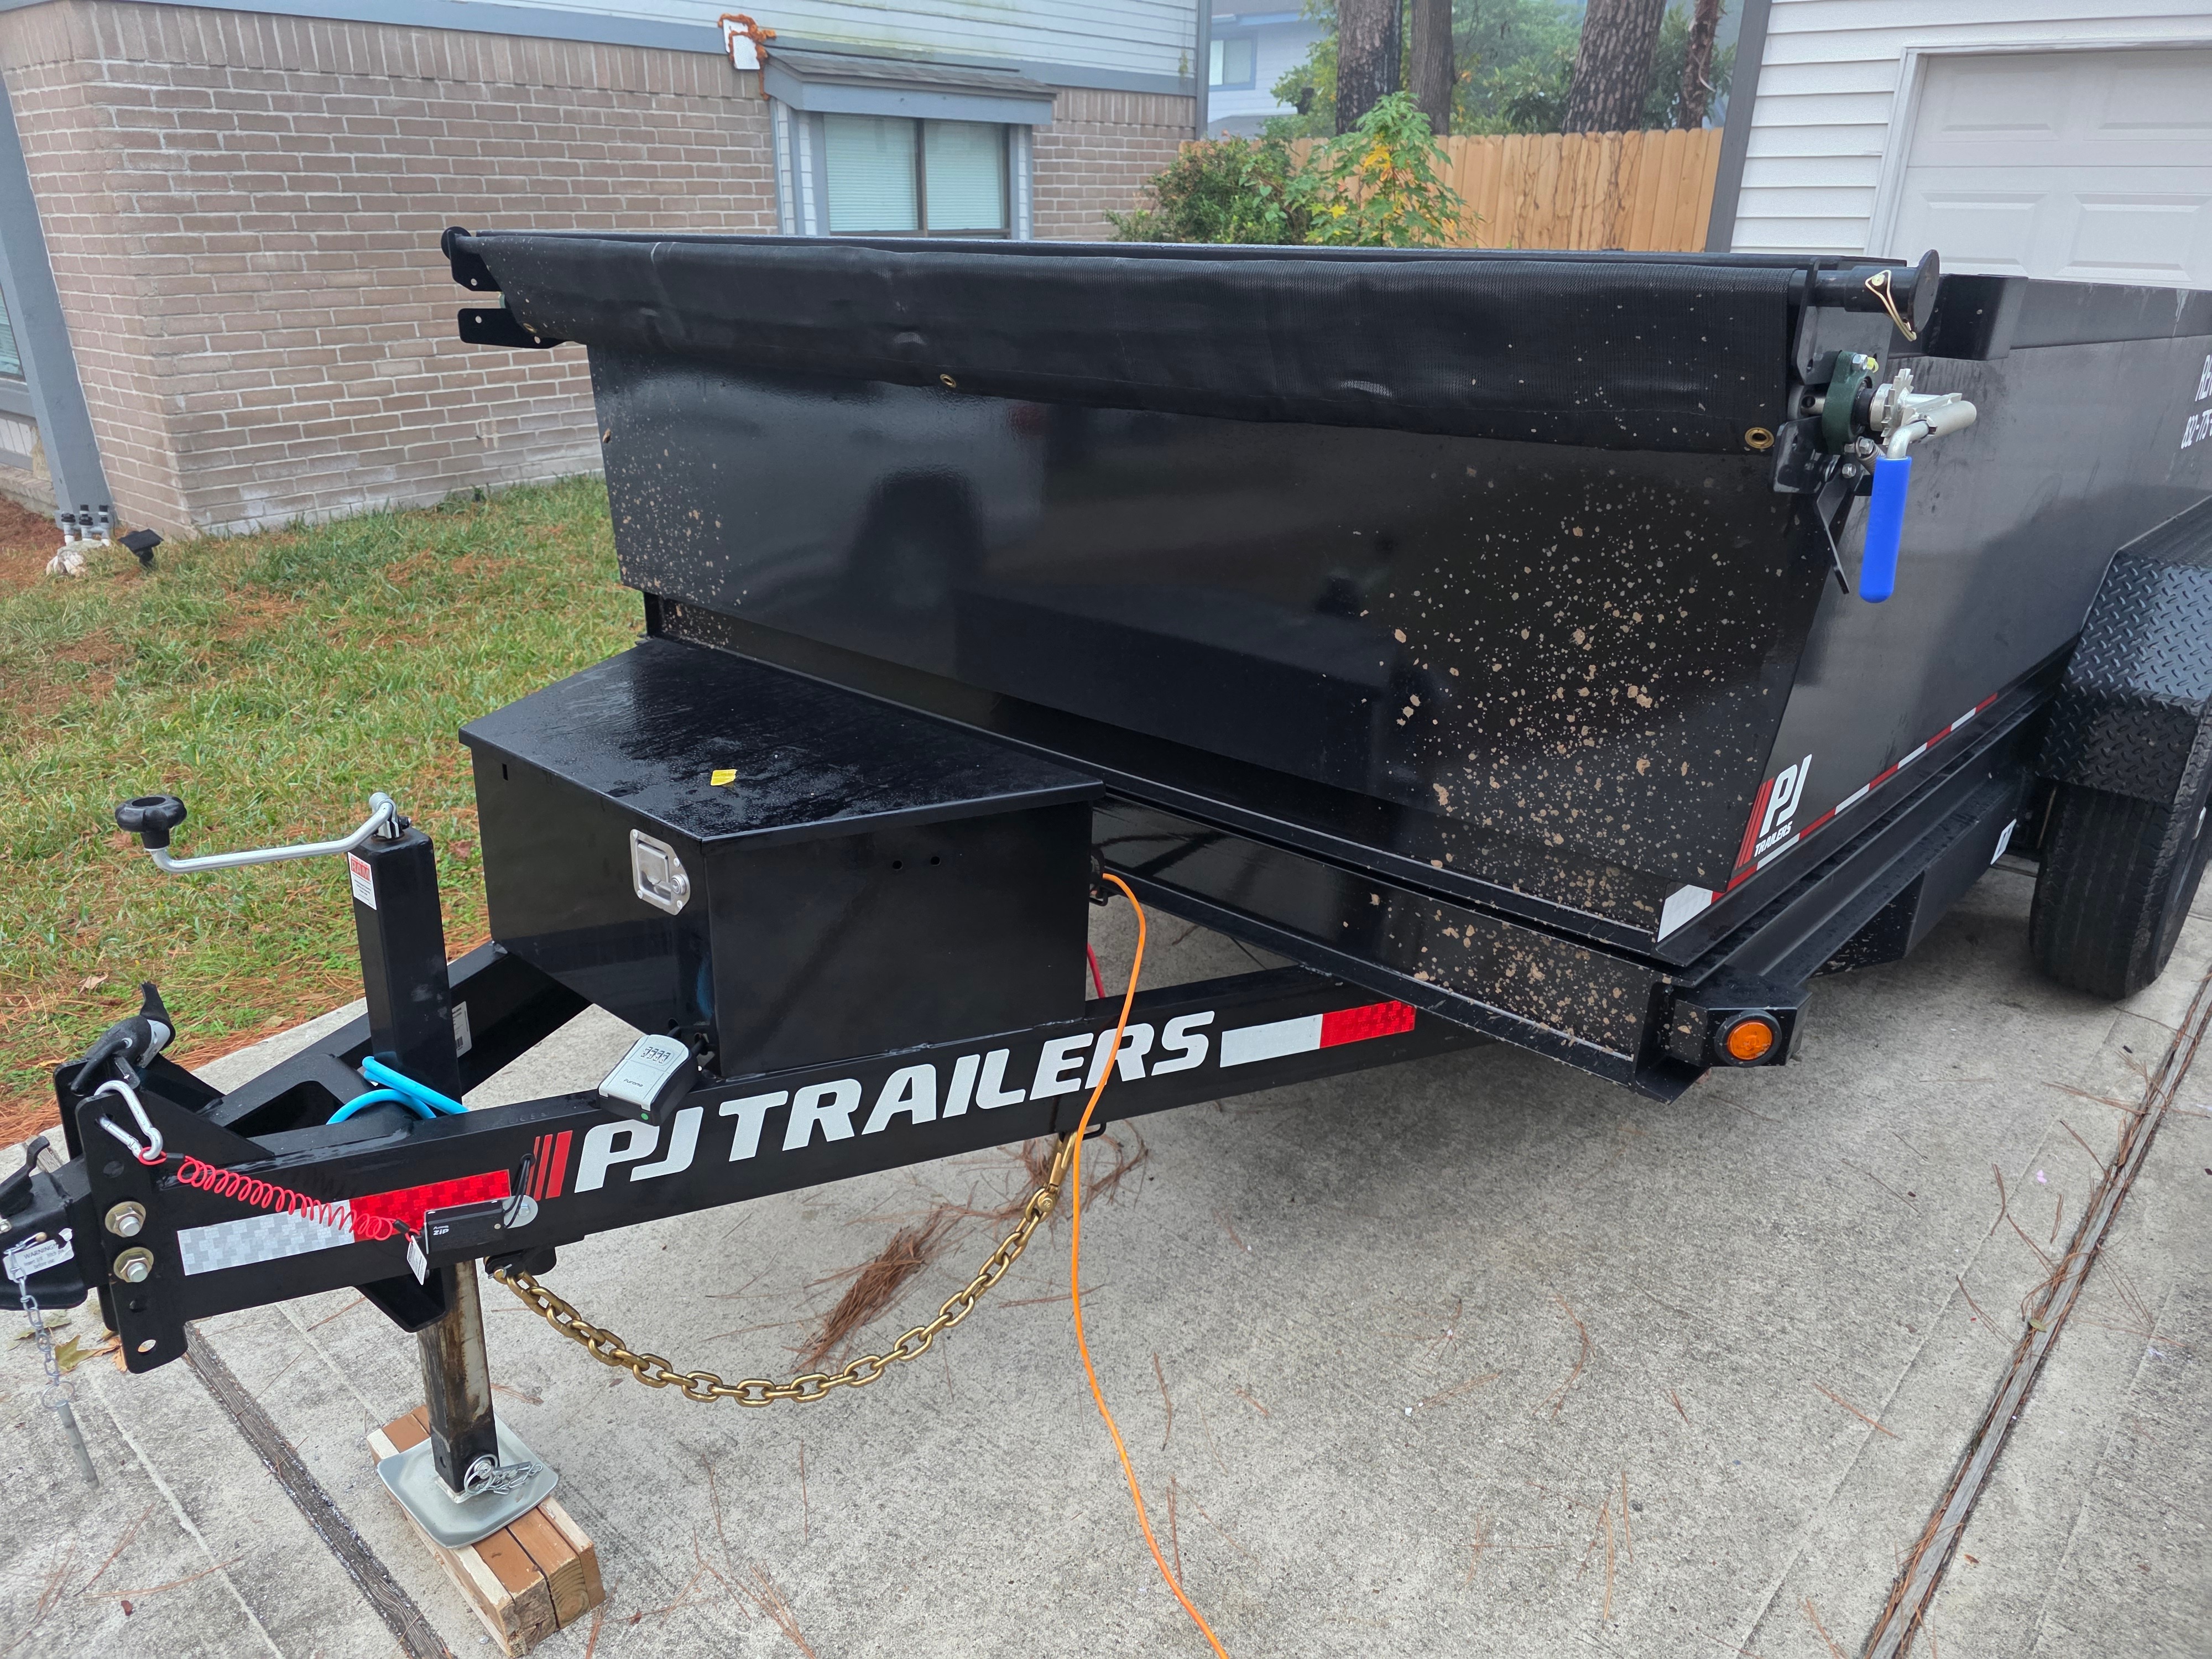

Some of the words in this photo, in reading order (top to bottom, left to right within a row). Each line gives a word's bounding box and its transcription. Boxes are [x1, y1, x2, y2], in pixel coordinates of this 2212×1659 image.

[2181, 408, 2212, 449] 832-775-
[1759, 754, 1812, 838] PJ
[1754, 821, 1793, 857] TRAILERS
[351, 858, 371, 881] RAM
[574, 1106, 704, 1193] PJ
[718, 1010, 1215, 1162] TRAILERS
